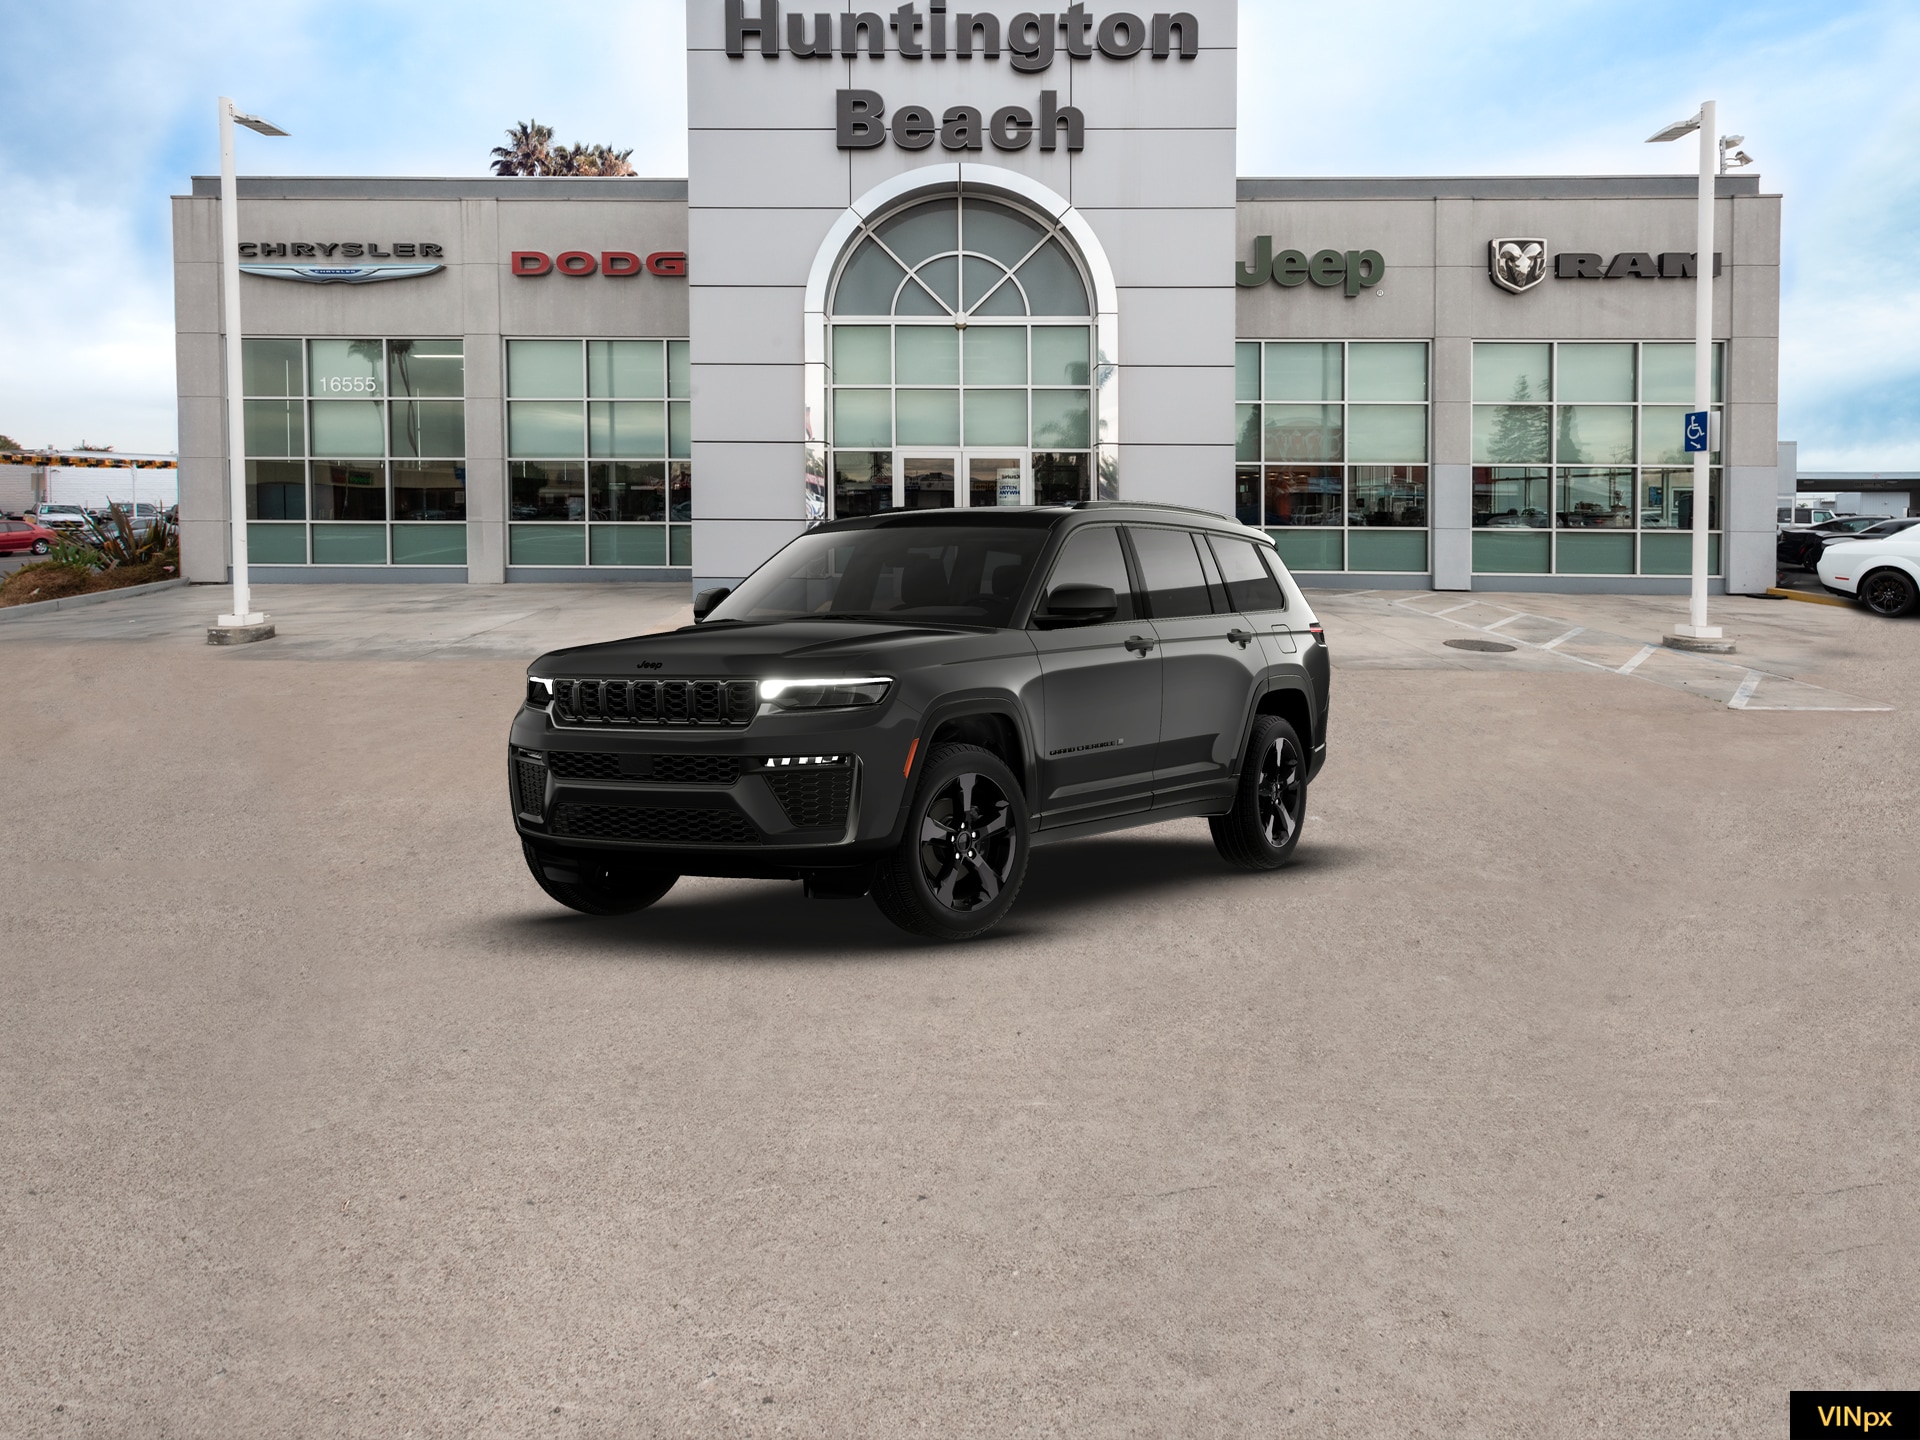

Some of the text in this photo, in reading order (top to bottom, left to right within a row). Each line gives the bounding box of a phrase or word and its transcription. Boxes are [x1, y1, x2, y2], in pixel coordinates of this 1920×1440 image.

[724, 0, 1200, 73] Huntington
[835, 88, 1086, 151] Beach
[239, 242, 444, 258] CHRYSLER
[1235, 235, 1386, 296] Jeep
[1554, 252, 1722, 280] RAM
[319, 376, 377, 392] 16555
[636, 660, 663, 671] Jeep
[1049, 747, 1075, 756] GRAND
